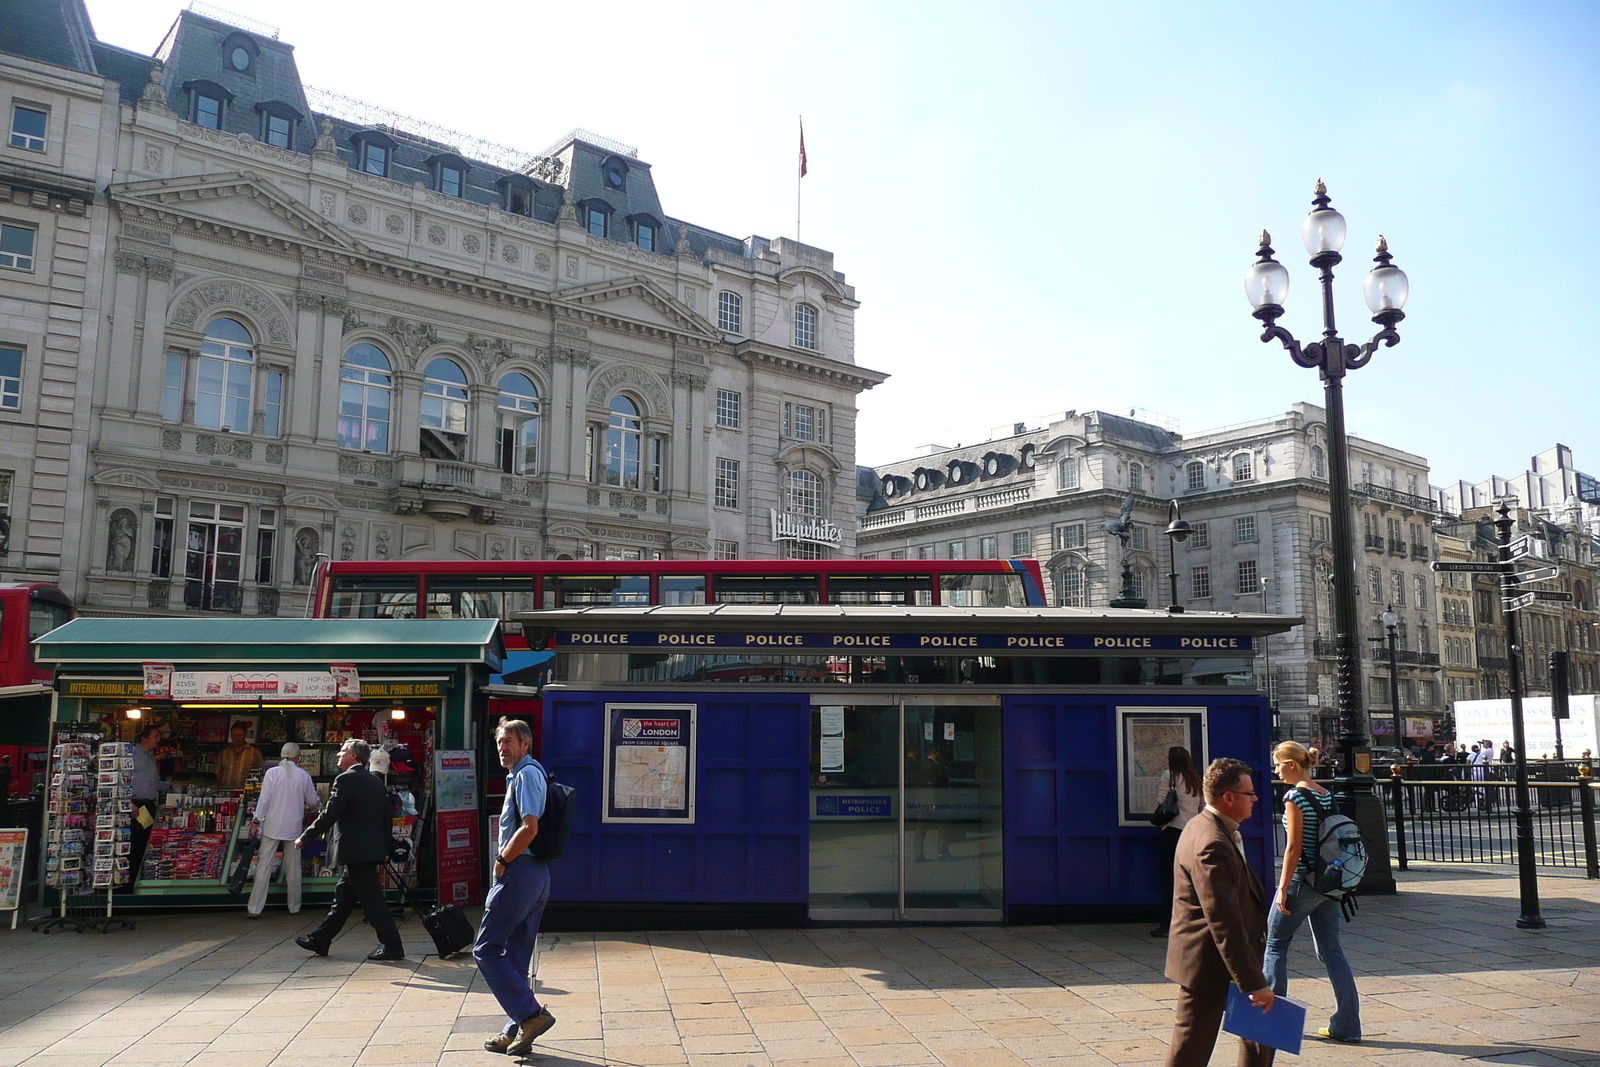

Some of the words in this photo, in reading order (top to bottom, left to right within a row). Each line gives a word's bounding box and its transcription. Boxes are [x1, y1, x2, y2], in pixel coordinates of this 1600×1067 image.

[770, 507, 843, 546] Lillywhites
[571, 633, 629, 644] POLICE
[657, 634, 717, 645] POLICE
[745, 634, 804, 645] POLICE
[833, 635, 891, 646] POLICE
[920, 636, 978, 647] POLICE
[1007, 637, 1065, 647] POLICE
[1094, 637, 1152, 648] POLICE
[1181, 637, 1238, 648] POLICE
[69, 682, 126, 694] INTERNATIONAL
[127, 683, 144, 695] PHO
[244, 681, 265, 690] Original
[360, 684, 388, 695] ATIONAL
[389, 684, 413, 695] PHONE
[414, 684, 439, 695] CARDS
[1462, 708, 1493, 719] DONAU
[906, 802, 929, 811] Working
[931, 802, 954, 811] together
